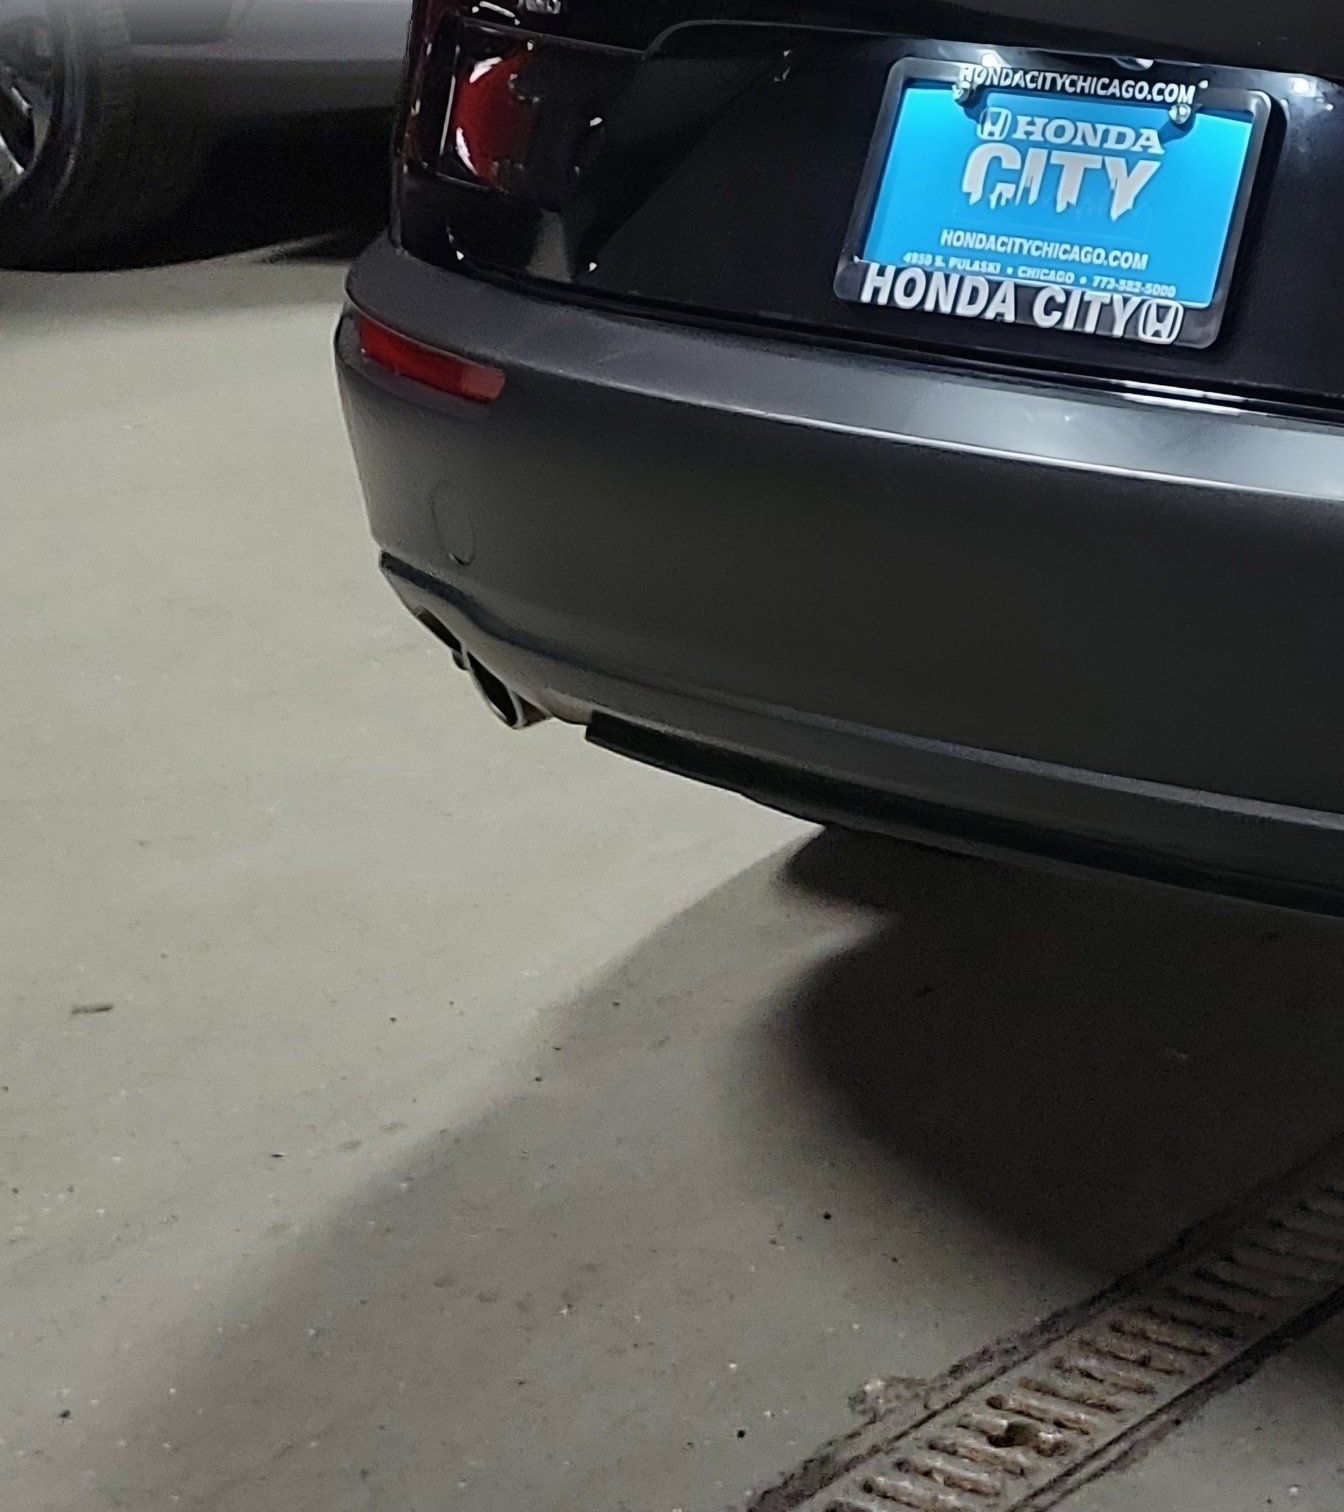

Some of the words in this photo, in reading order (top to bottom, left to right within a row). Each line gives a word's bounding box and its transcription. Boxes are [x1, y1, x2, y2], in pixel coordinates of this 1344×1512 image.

[958, 64, 1196, 105] HONDACITYCHICAGO.COM
[1015, 118, 1165, 155] HONDA
[962, 142, 1162, 222] CITY
[940, 228, 1149, 271] HONDACITYCHICAGO.COM
[1017, 265, 1075, 285] CHICAGO
[860, 264, 1017, 324] HONDA
[1032, 285, 1144, 338] CITY
